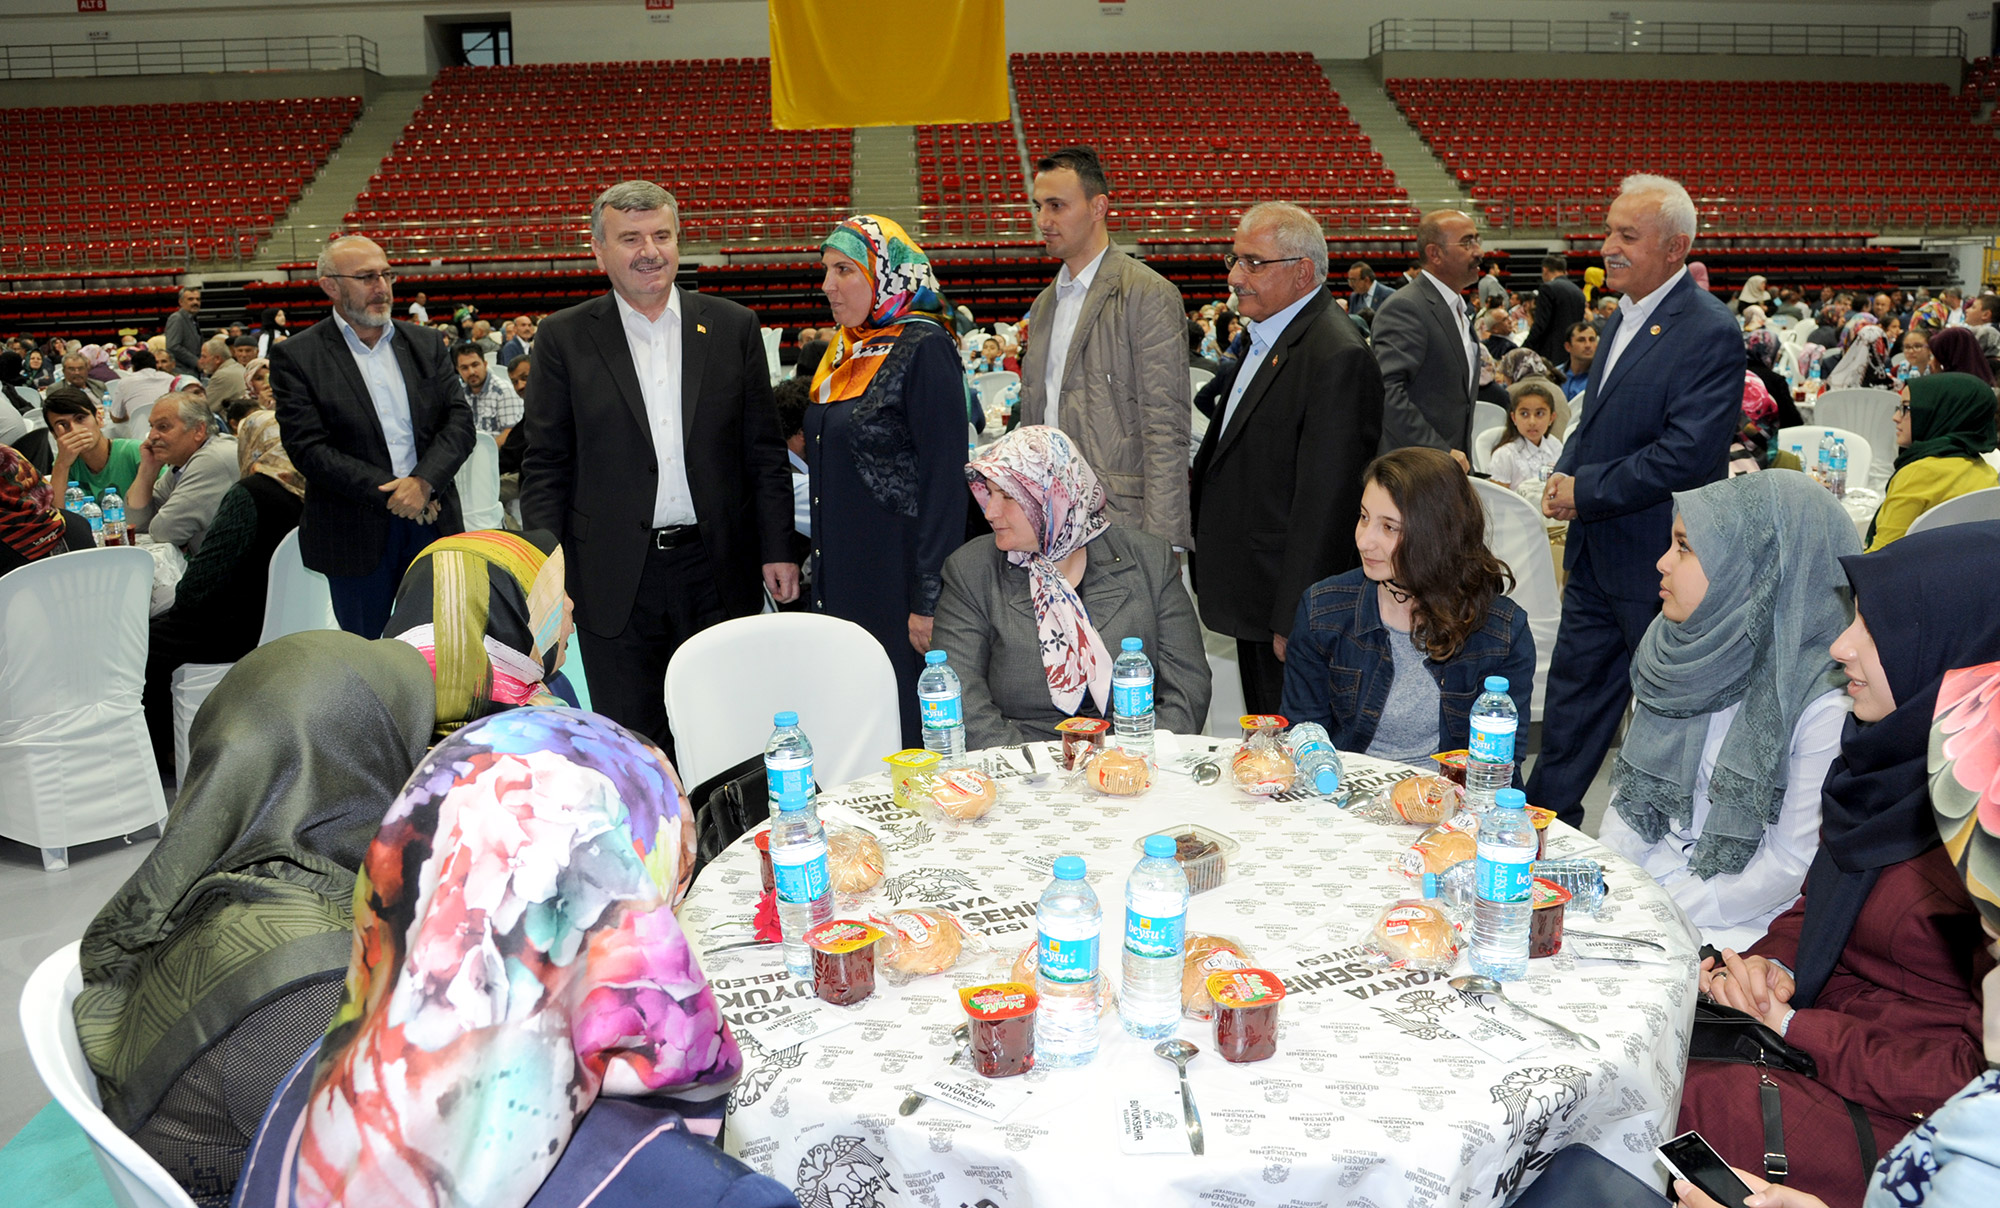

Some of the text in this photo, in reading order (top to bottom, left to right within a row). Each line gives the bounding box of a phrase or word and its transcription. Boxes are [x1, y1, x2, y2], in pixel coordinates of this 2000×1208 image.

[935, 895, 998, 913] NYA
[1128, 919, 1160, 940] beysu
[723, 1005, 792, 1027] KON
[954, 1082, 986, 1097] KONYA
